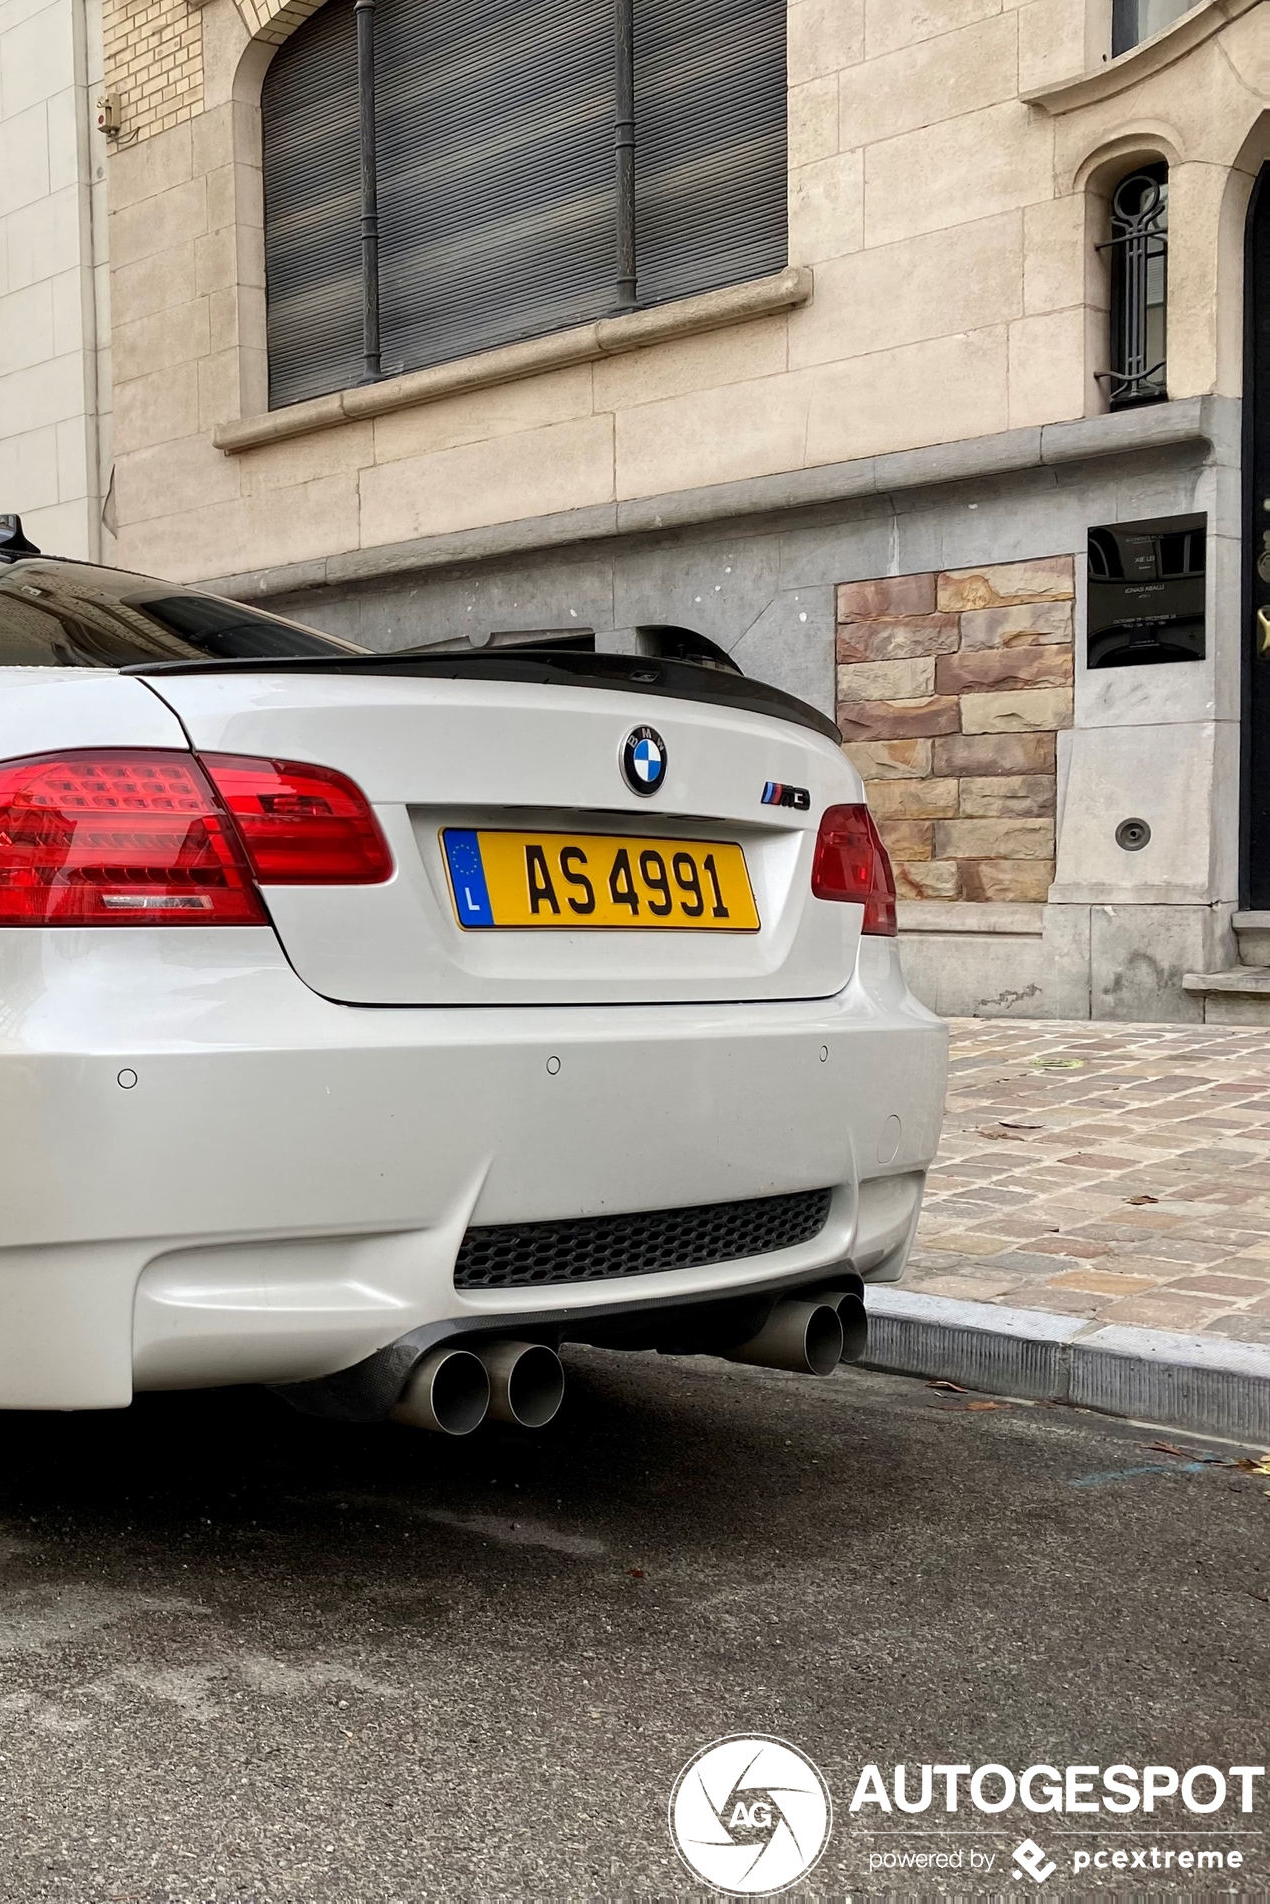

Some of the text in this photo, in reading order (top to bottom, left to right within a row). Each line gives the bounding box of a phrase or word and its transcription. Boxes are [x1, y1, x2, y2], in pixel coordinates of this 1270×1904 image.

[627, 728, 665, 751] BMW
[778, 783, 811, 811] M3
[524, 844, 730, 918] AS 4991
[466, 887, 480, 912] L
